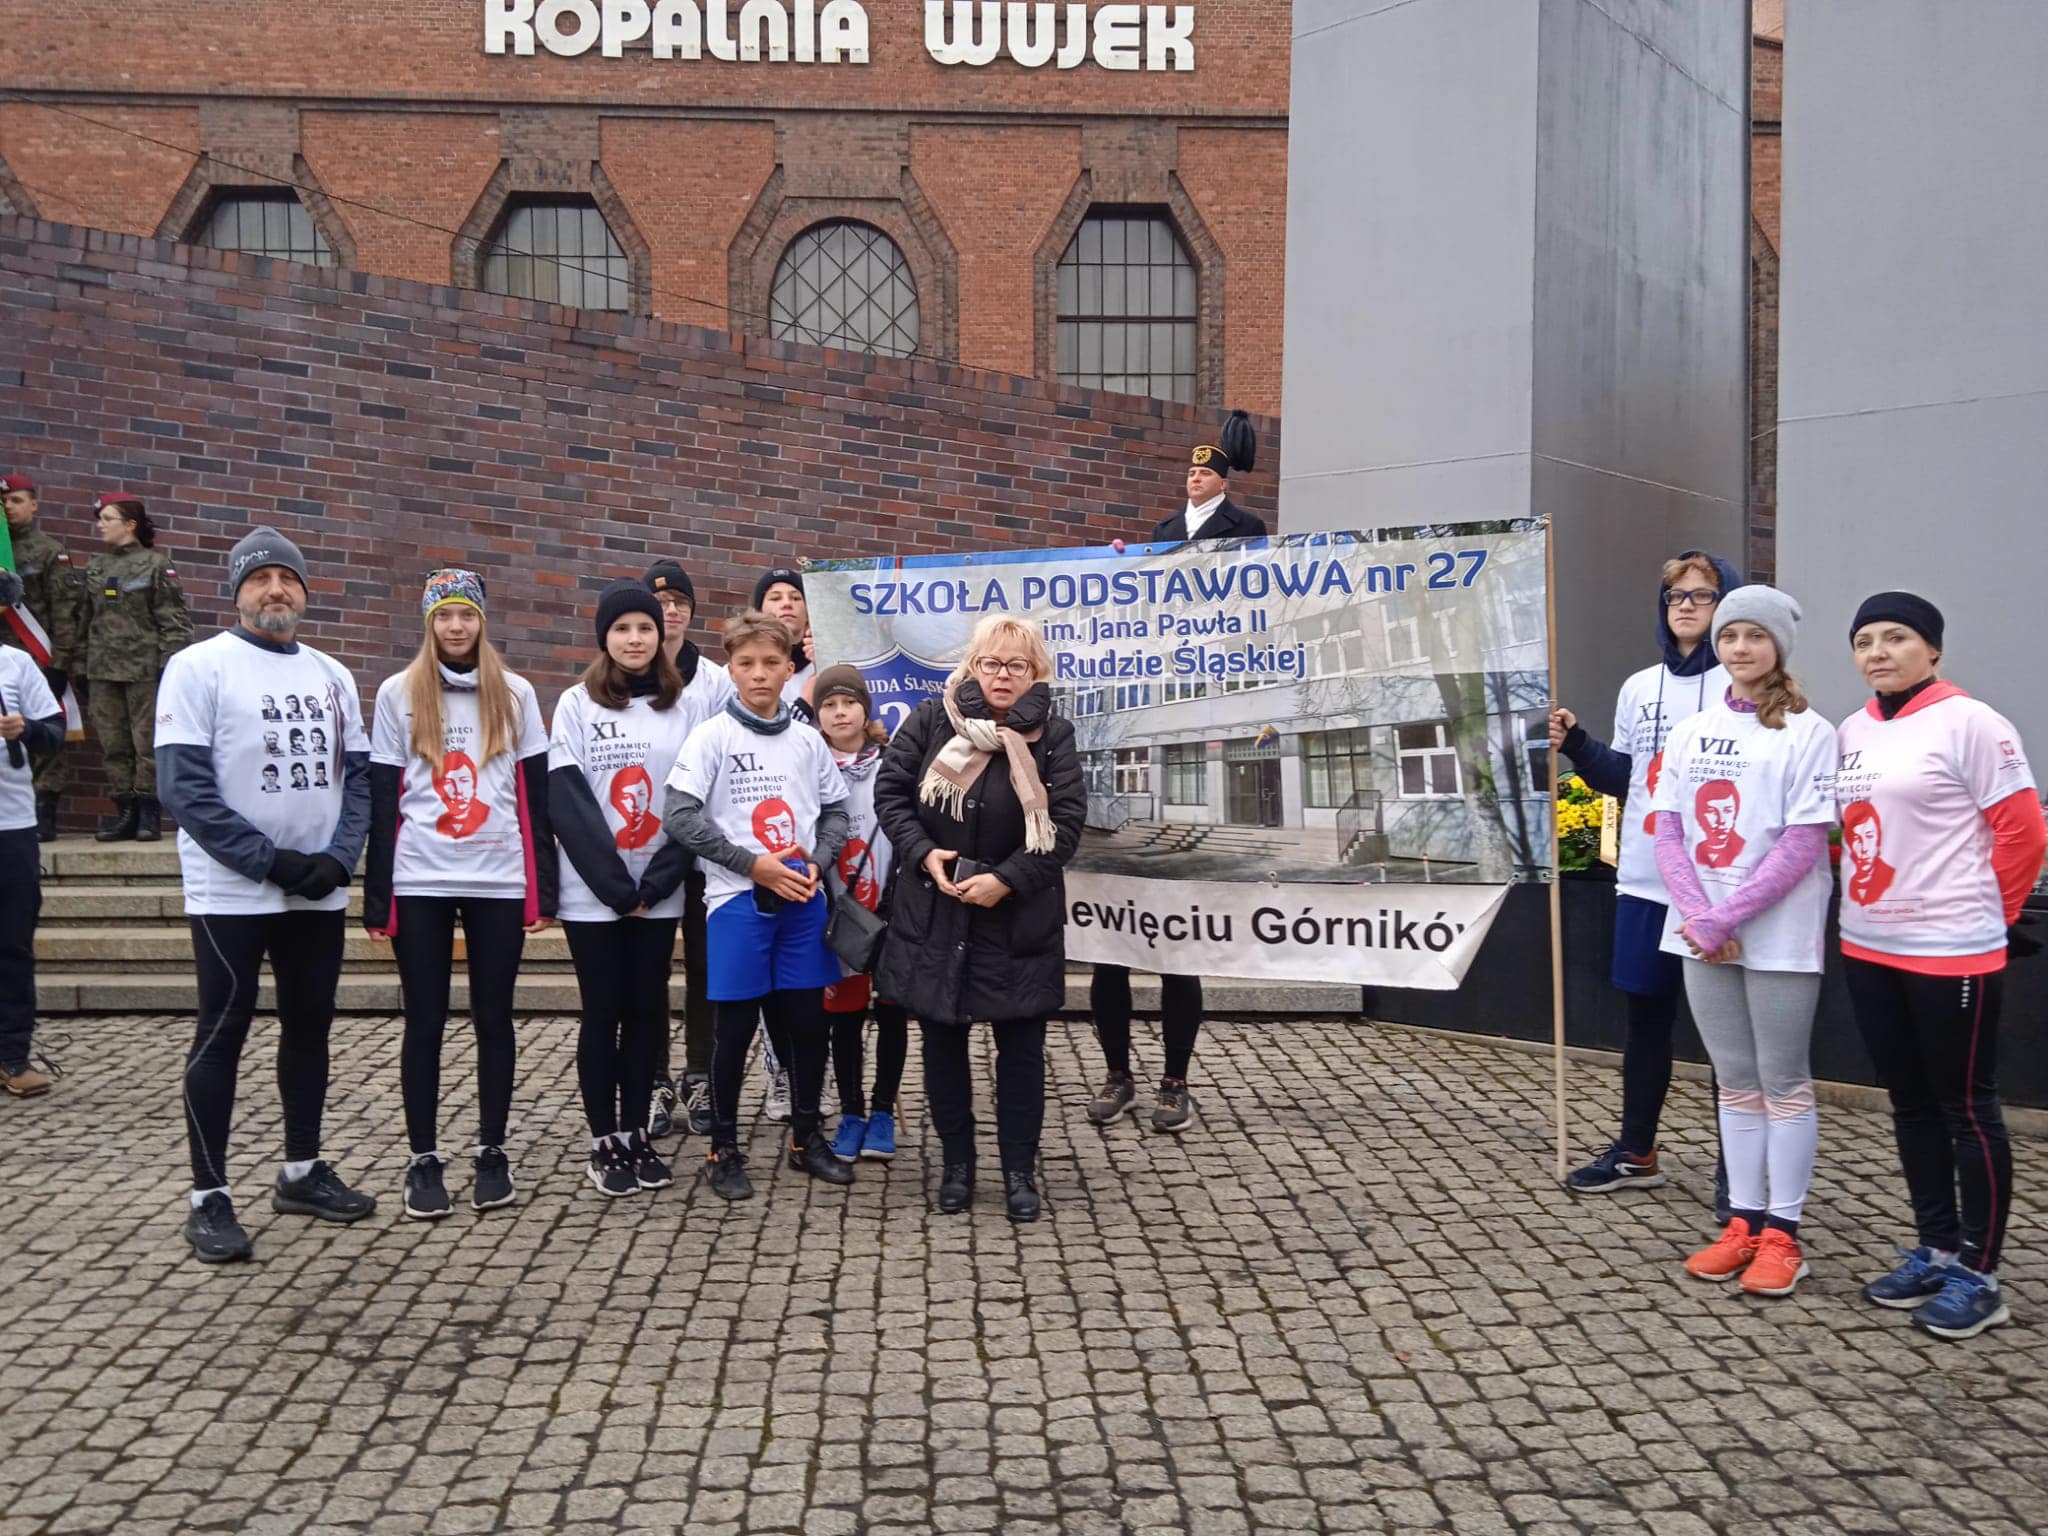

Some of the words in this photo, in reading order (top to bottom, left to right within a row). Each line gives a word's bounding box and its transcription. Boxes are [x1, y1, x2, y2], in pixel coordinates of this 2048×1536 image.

[484, 0, 870, 64] KOPALNIA
[924, 0, 1195, 71] WUJEK
[850, 576, 1010, 615] SZKOŁA
[1022, 558, 1353, 610] PODSTAWOWA
[1367, 563, 1416, 593] nr
[1427, 549, 1488, 590] 27
[1043, 619, 1082, 642] im.
[1090, 616, 1150, 645] Jana
[1157, 609, 1242, 638] Pawła
[1251, 609, 1267, 633] II
[1055, 649, 1163, 681] Rudzie
[1174, 637, 1306, 682] Śląskiej
[864, 678, 902, 695] UDA
[590, 720, 627, 742] XI.
[879, 701, 913, 747] 2
[728, 752, 764, 774] XI.
[1699, 736, 1741, 756] VII.
[1063, 898, 1233, 949] ewięciu
[1251, 906, 1465, 953] Górnikó
